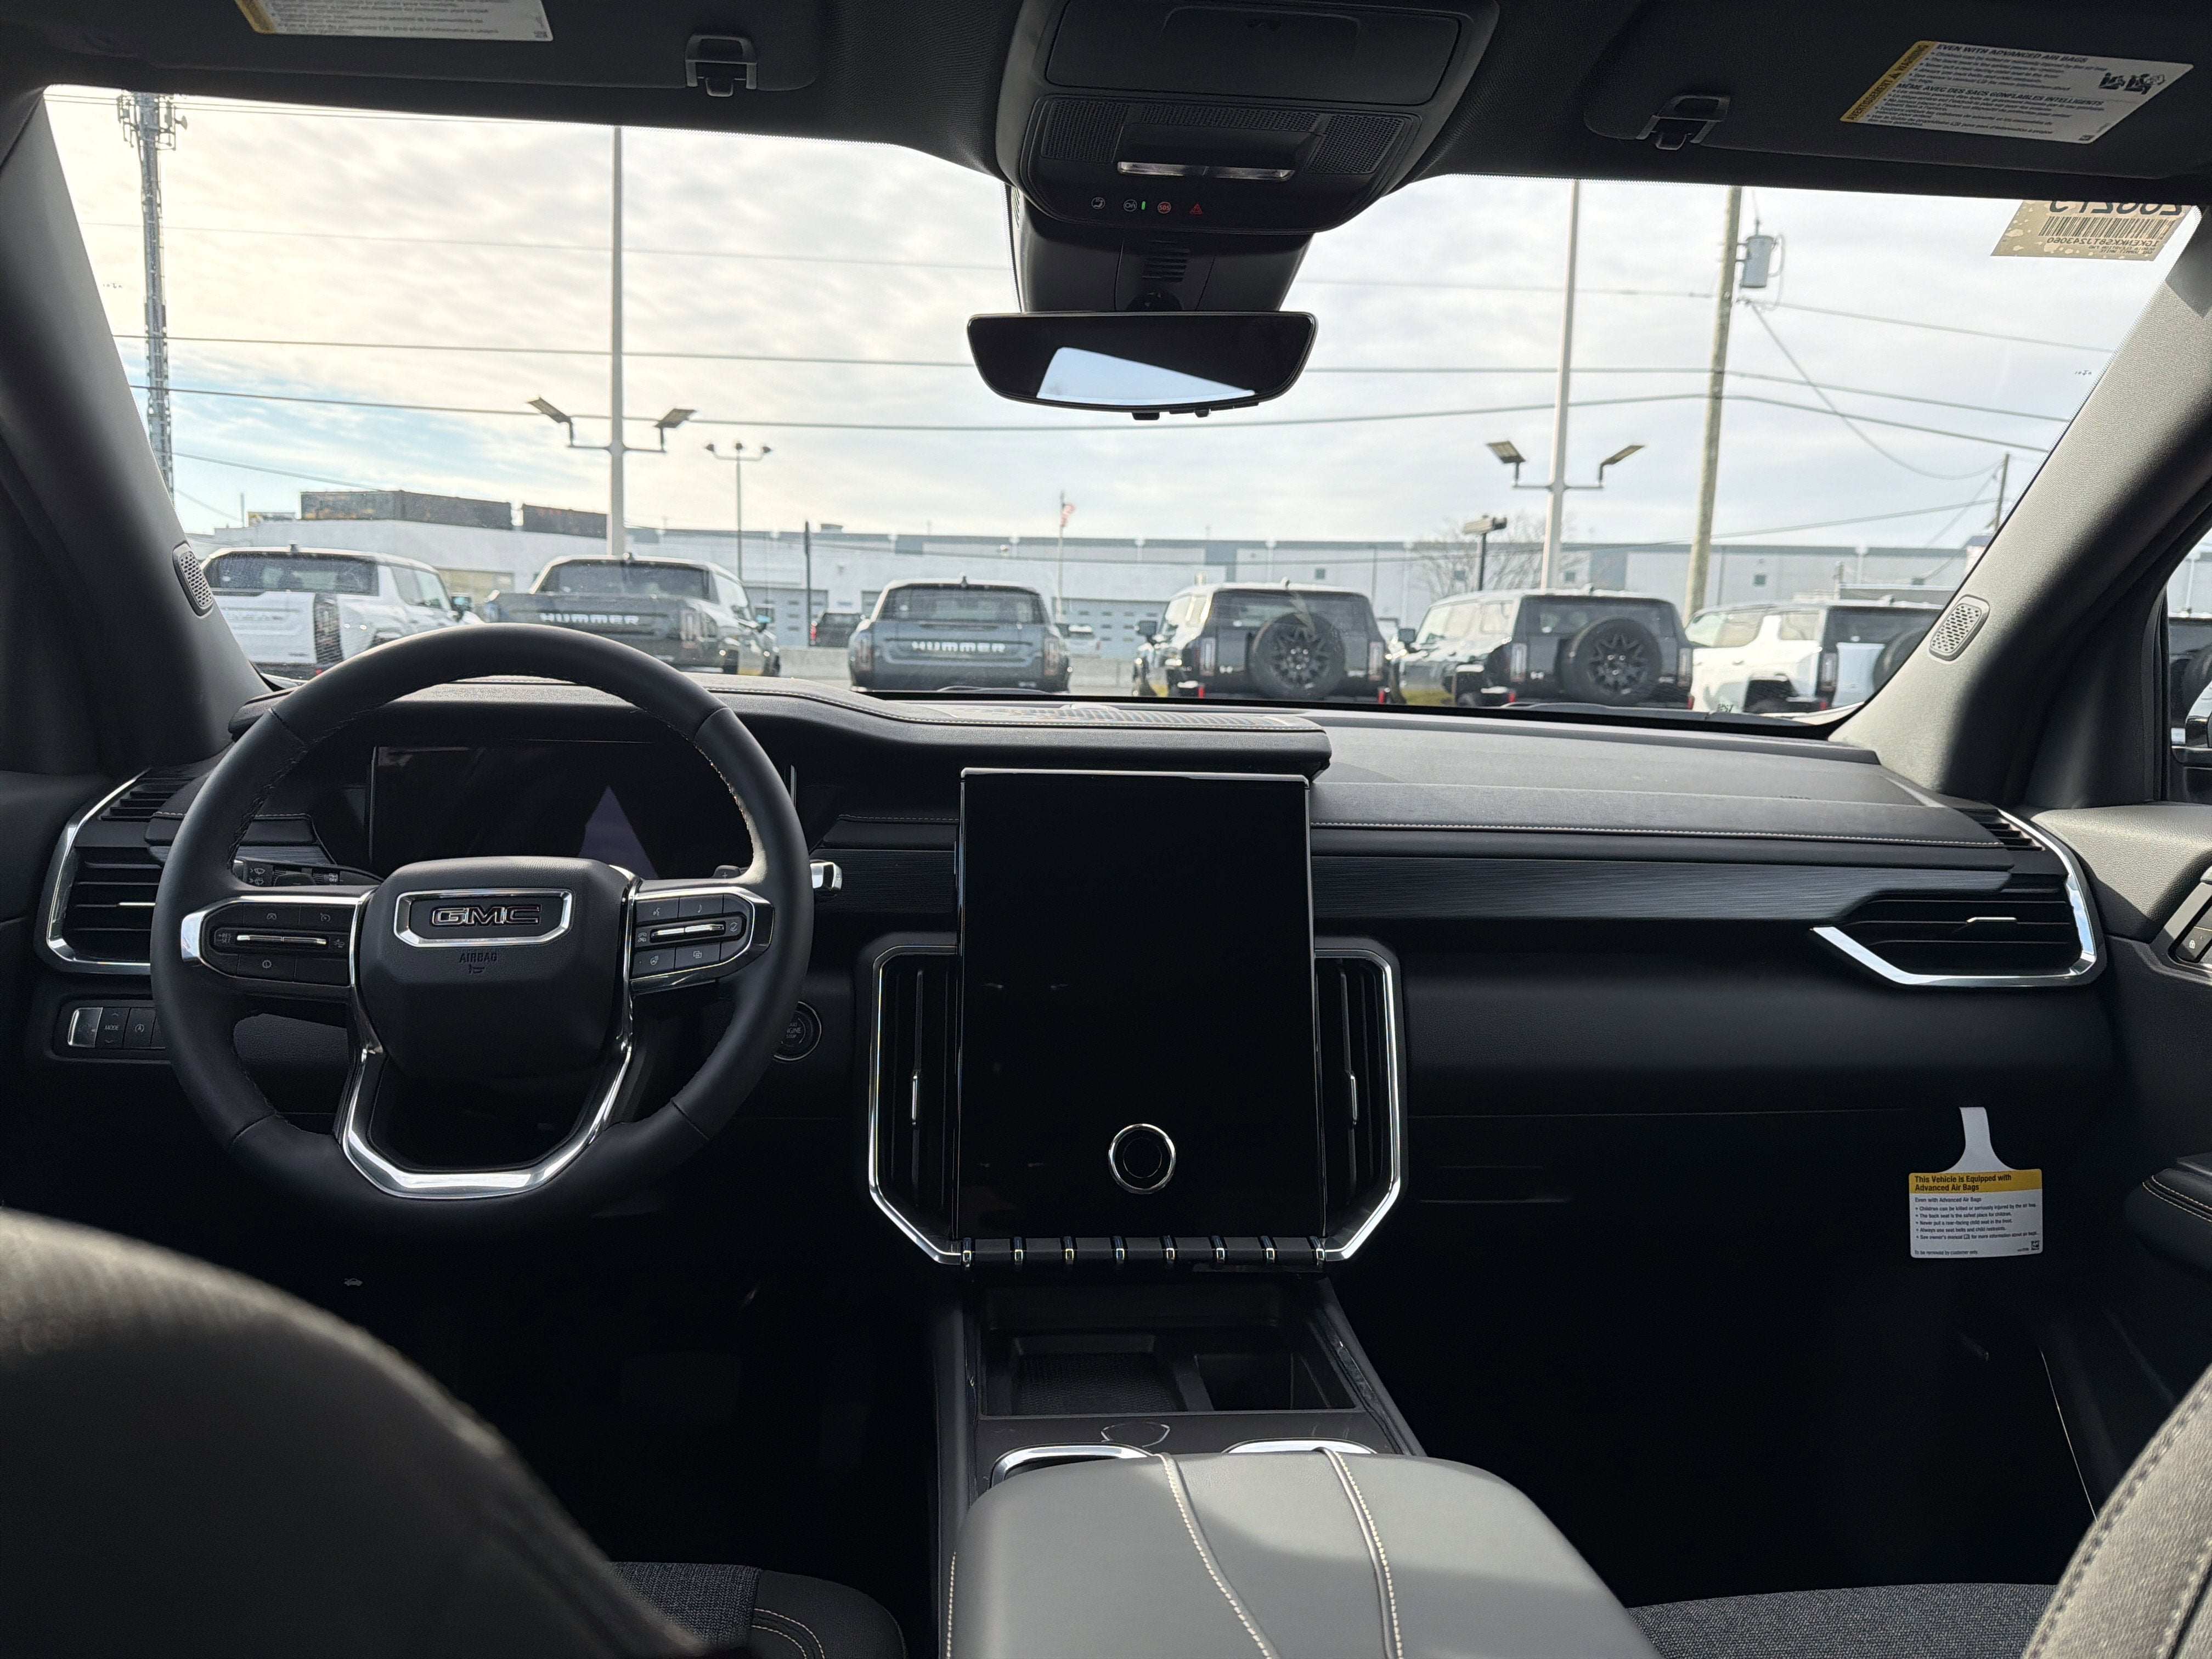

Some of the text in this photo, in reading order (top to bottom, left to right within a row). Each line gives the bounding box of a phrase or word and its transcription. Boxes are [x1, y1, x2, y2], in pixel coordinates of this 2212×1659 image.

[1936, 44, 1961, 52] EVEN
[1963, 46, 1988, 54] WITH
[1989, 49, 2041, 59] ADVANCED
[2059, 55, 2088, 63] BAGS
[1923, 85, 1948, 93] AVEC
[1966, 88, 1988, 97] SACS
[1989, 90, 2044, 101] GONFLABLES
[2044, 94, 2104, 106] INTELLIGENTS
[539, 613, 640, 625] HUMMER
[911, 641, 1006, 653] HUMMER
[432, 905, 541, 926] GMC
[459, 952, 498, 963] AIRBAG
[1966, 1174, 1996, 1183] Equipped
[1963, 1183, 1979, 1192] Bags
